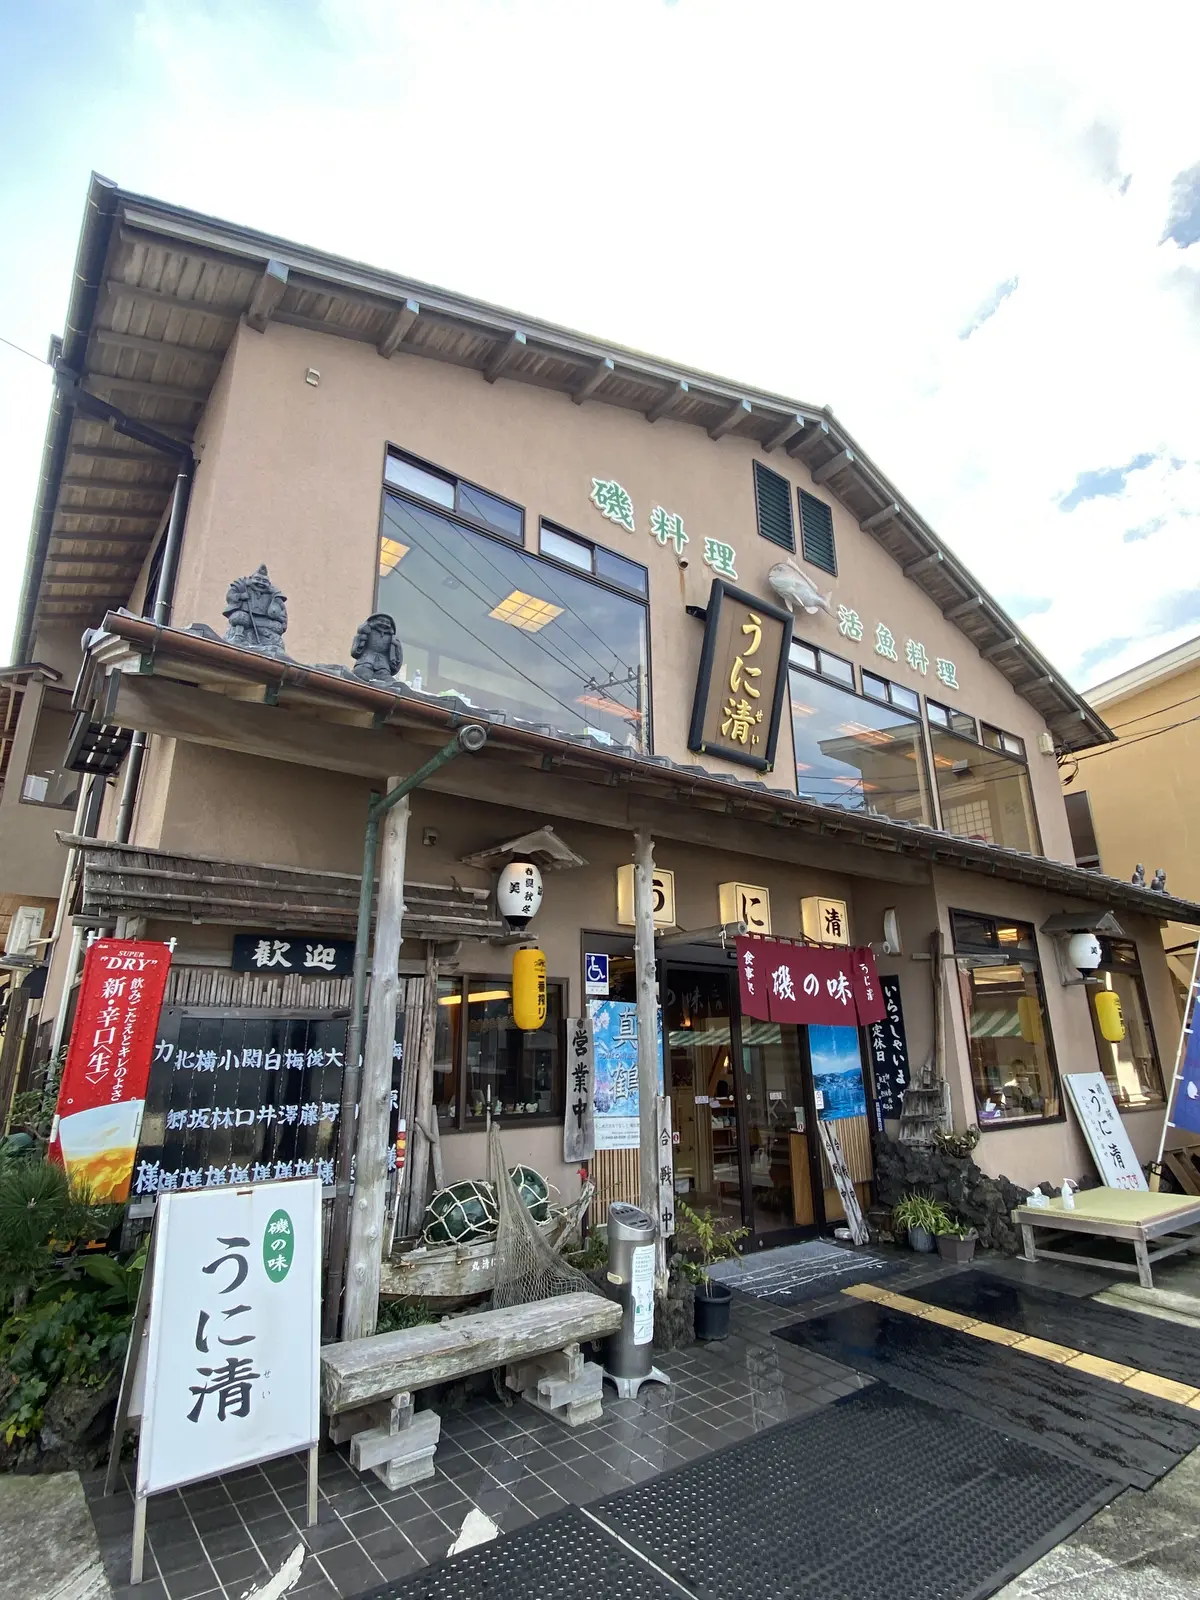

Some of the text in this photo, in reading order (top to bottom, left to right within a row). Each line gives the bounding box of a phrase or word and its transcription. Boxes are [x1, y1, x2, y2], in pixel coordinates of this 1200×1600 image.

[590, 477, 738, 580] 磯料理
[721, 613, 762, 744] うに清
[837, 604, 960, 690] 活魚料理
[118, 950, 145, 958] SUPER
[251, 940, 338, 971] 歓迎
[741, 892, 764, 927] に
[824, 907, 841, 938] 清
[771, 964, 853, 1006] 磯の味
[110, 977, 145, 1101] 飲みごたえとキレのよさ
[572, 1029, 590, 1129] 営業中
[871, 1023, 887, 1062] 定休日
[1088, 1088, 1125, 1169] うに清
[659, 1128, 673, 1232] 合戦中
[267, 1217, 291, 1272] 磯の味
[186, 1236, 261, 1423] うに清
[262, 1369, 271, 1400] せい
